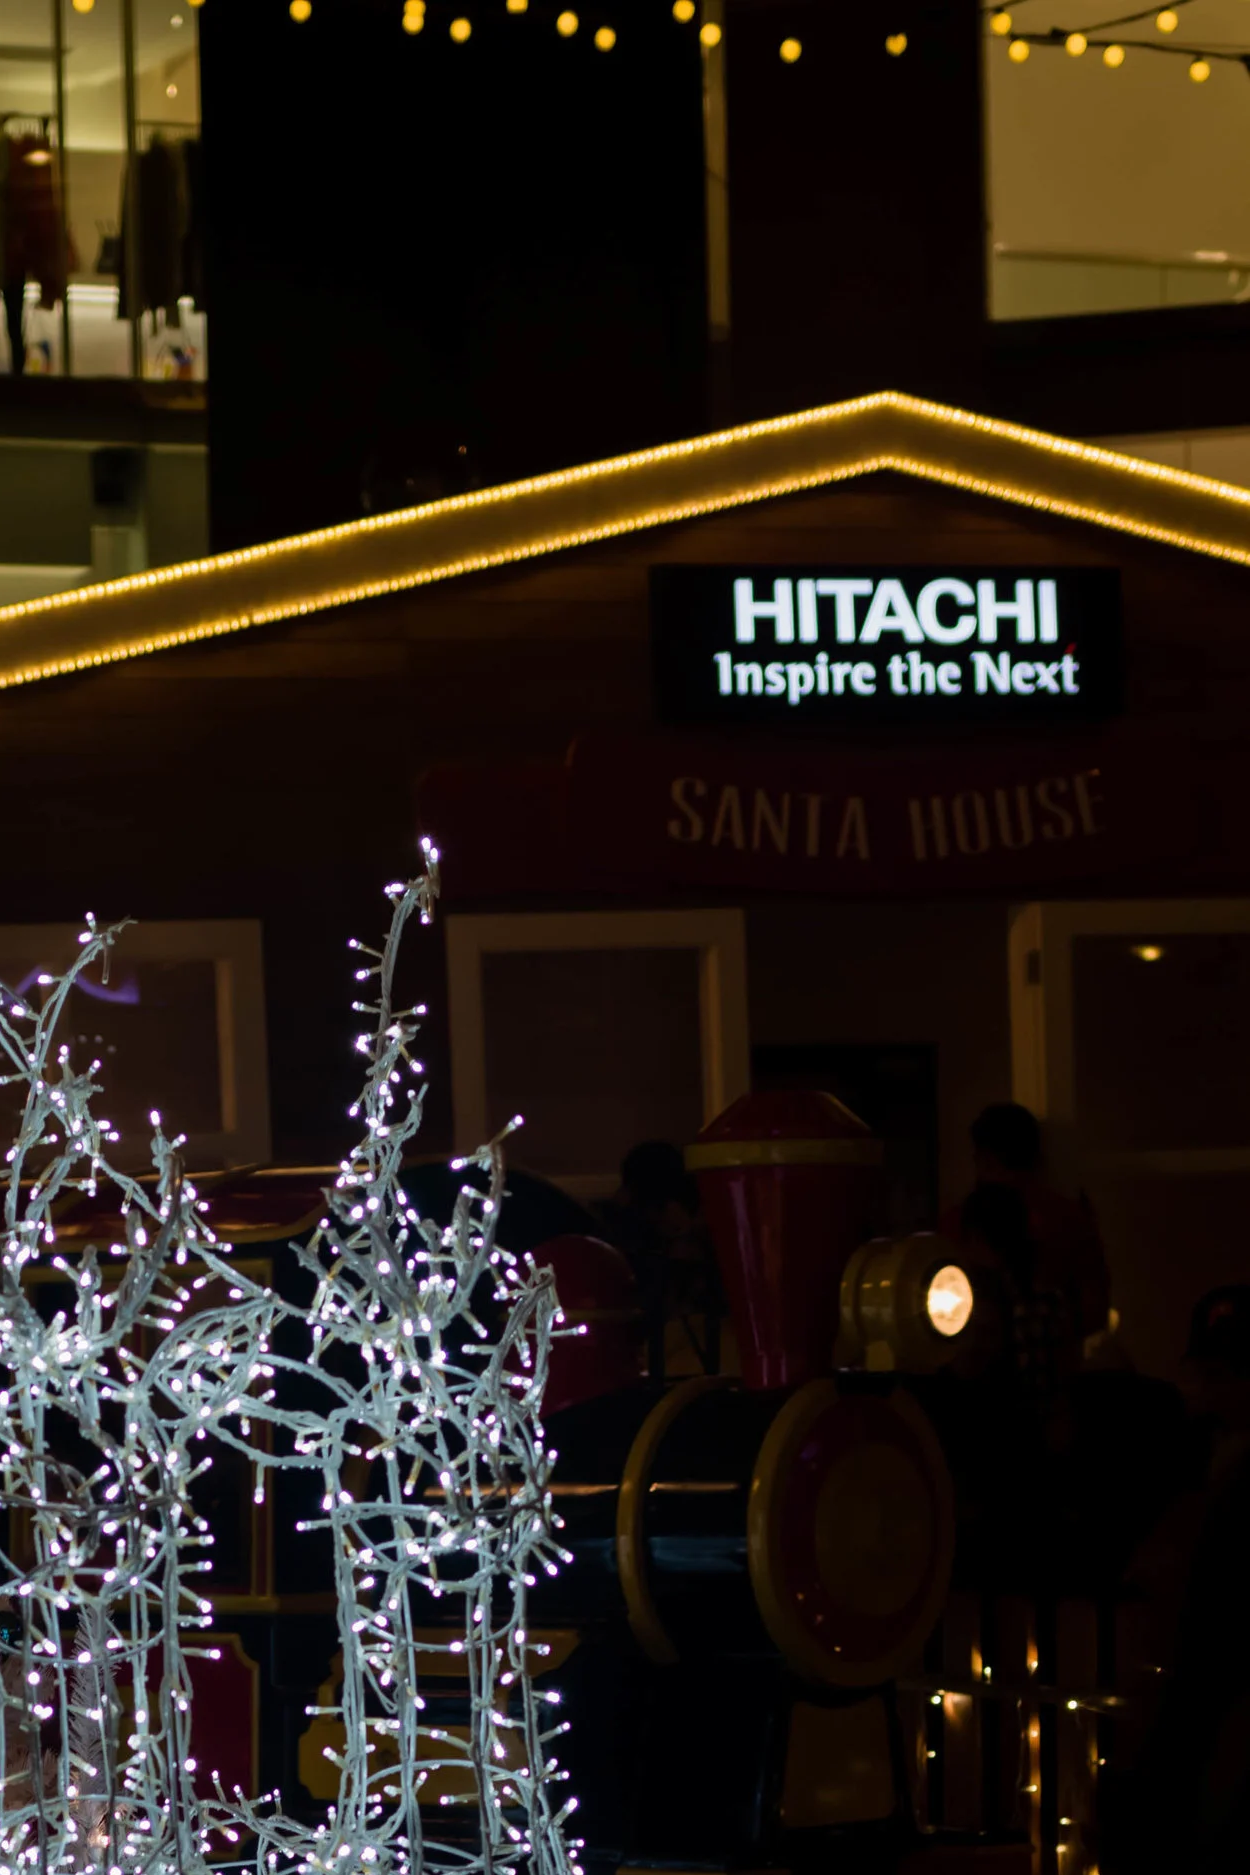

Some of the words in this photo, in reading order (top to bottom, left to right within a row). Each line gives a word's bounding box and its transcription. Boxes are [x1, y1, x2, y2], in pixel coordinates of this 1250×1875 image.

[732, 576, 1060, 645] HITACHI
[713, 651, 877, 706] Inspire
[886, 650, 962, 695] the
[969, 648, 1080, 696] Next
[667, 776, 871, 862] SANTA
[906, 767, 1105, 862] HOUSE
